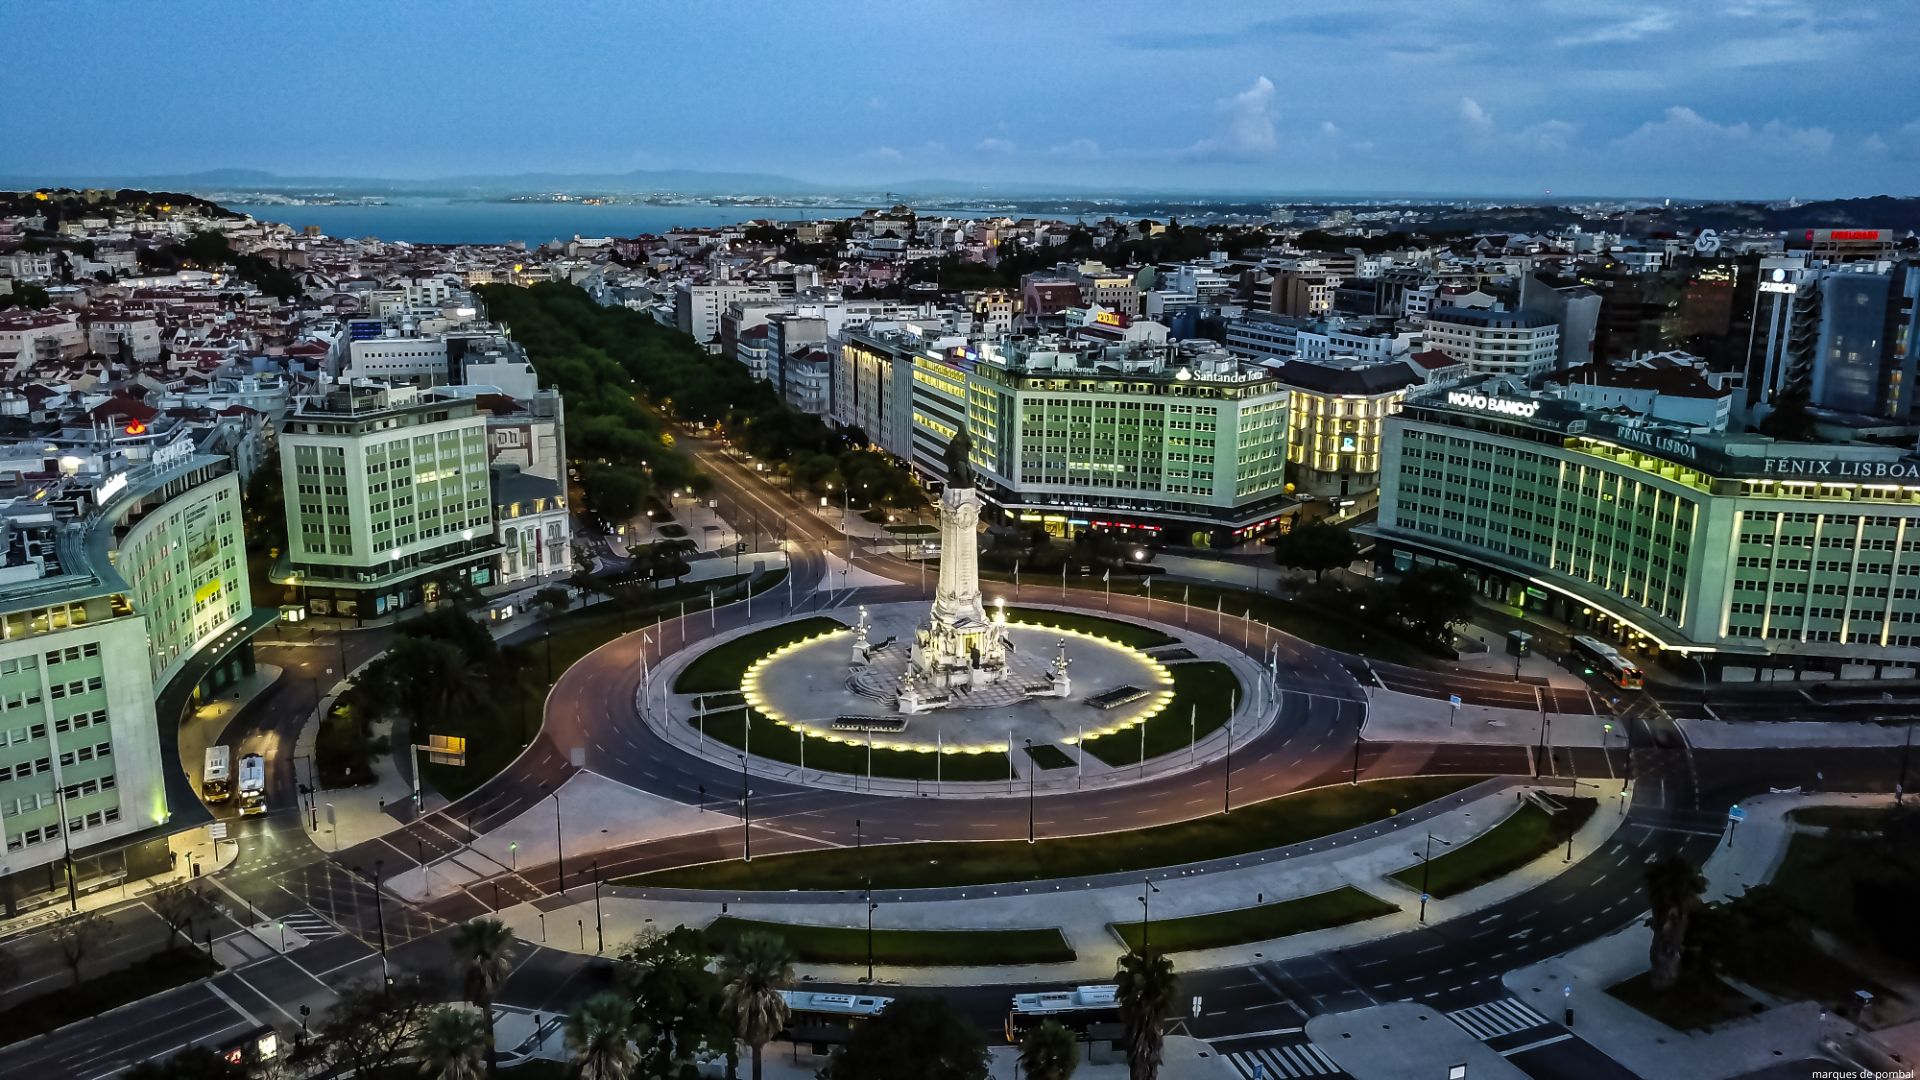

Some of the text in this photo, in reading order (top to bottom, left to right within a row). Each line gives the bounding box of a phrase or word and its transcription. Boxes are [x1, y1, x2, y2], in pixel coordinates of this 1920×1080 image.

[1759, 281, 1797, 294] ZURICH
[1193, 370, 1246, 383] Santander
[1448, 391, 1535, 417] NOVO BANCO
[1656, 436, 1697, 459] LISBOA
[1764, 456, 1920, 478] FÉNIX LISBOA
